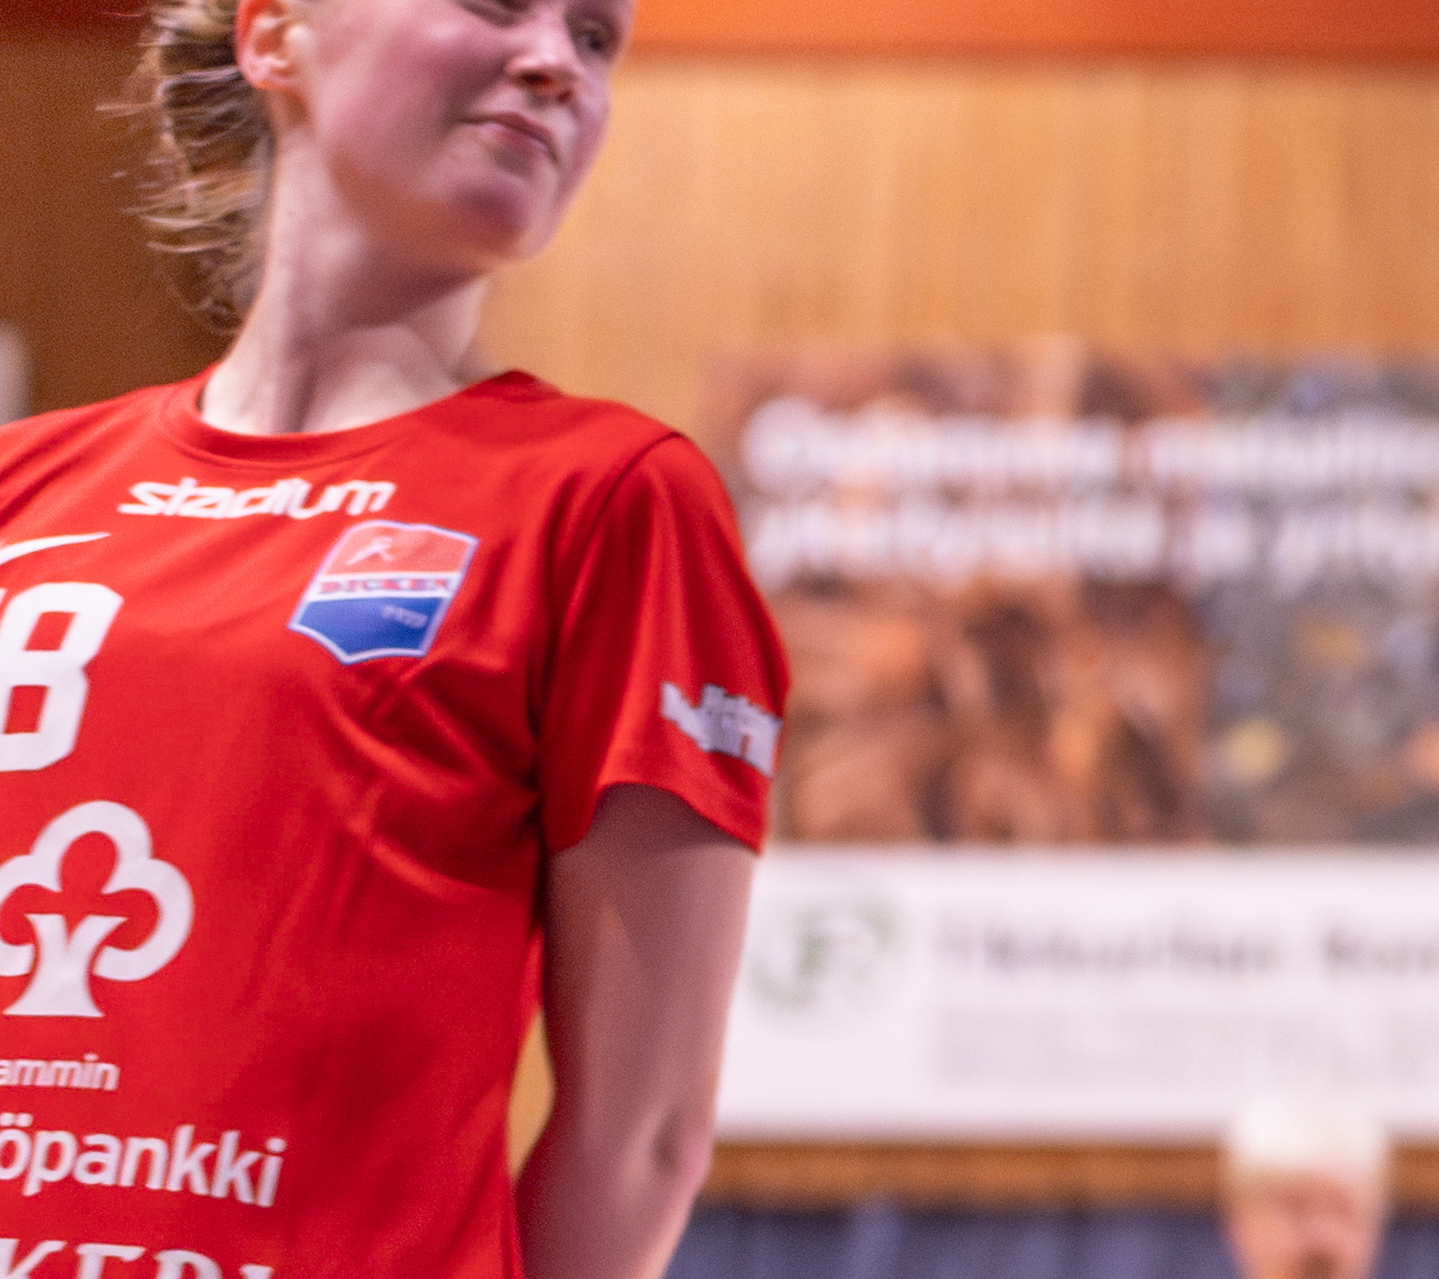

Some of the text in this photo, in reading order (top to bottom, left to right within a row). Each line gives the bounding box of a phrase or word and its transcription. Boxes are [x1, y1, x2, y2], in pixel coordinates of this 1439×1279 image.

[118, 477, 396, 520] stadium
[0, 584, 124, 772] 8
[0, 1053, 120, 1091] ammin
[0, 1112, 286, 1208] öpankki
